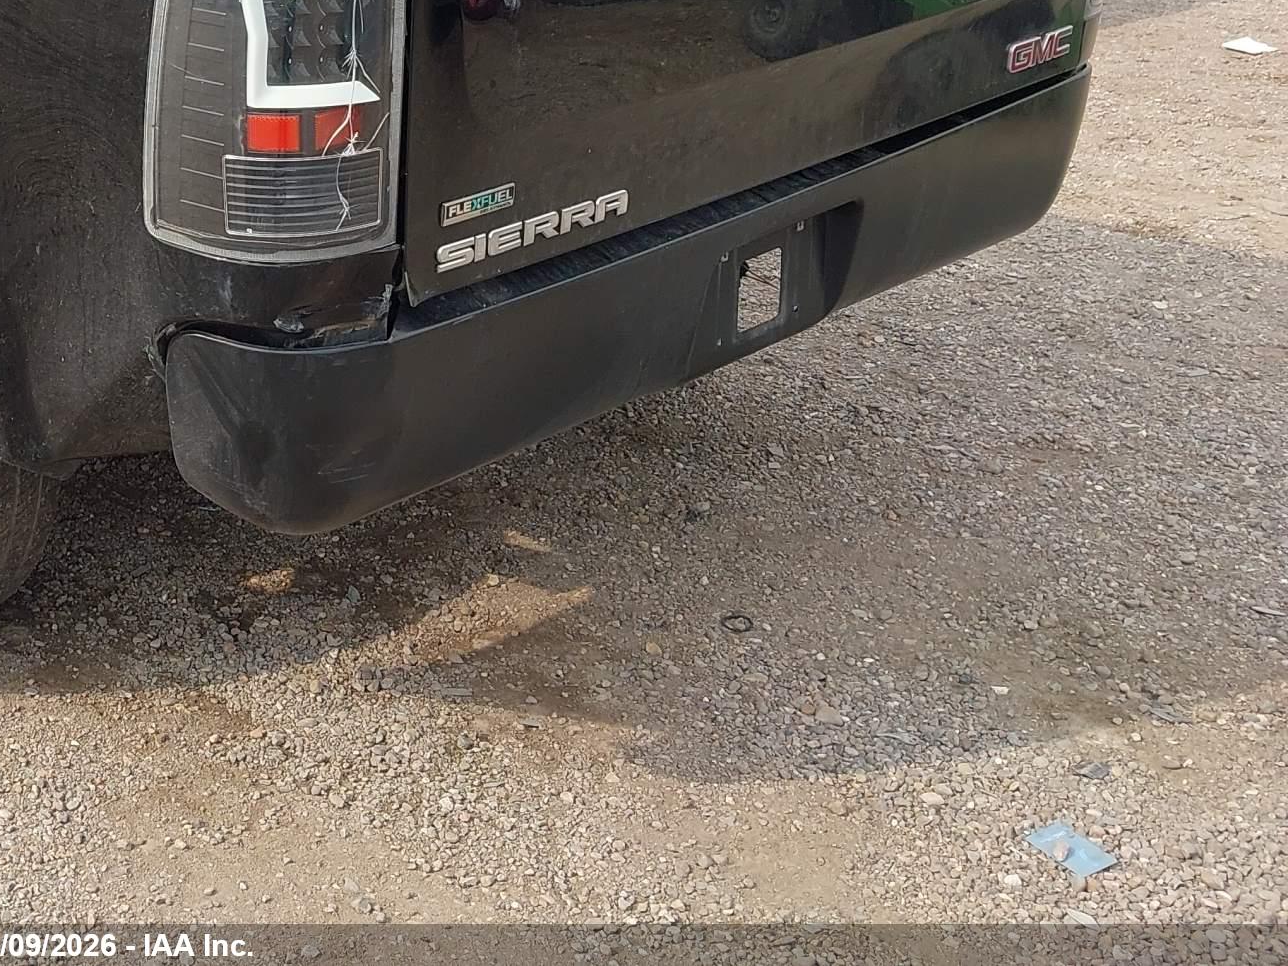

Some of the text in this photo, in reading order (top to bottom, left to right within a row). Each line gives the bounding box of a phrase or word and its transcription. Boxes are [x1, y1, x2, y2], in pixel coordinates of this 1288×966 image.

[1008, 25, 1073, 73] GMC
[448, 187, 513, 218] FLEXFUEL
[436, 189, 629, 274] SIERRA
